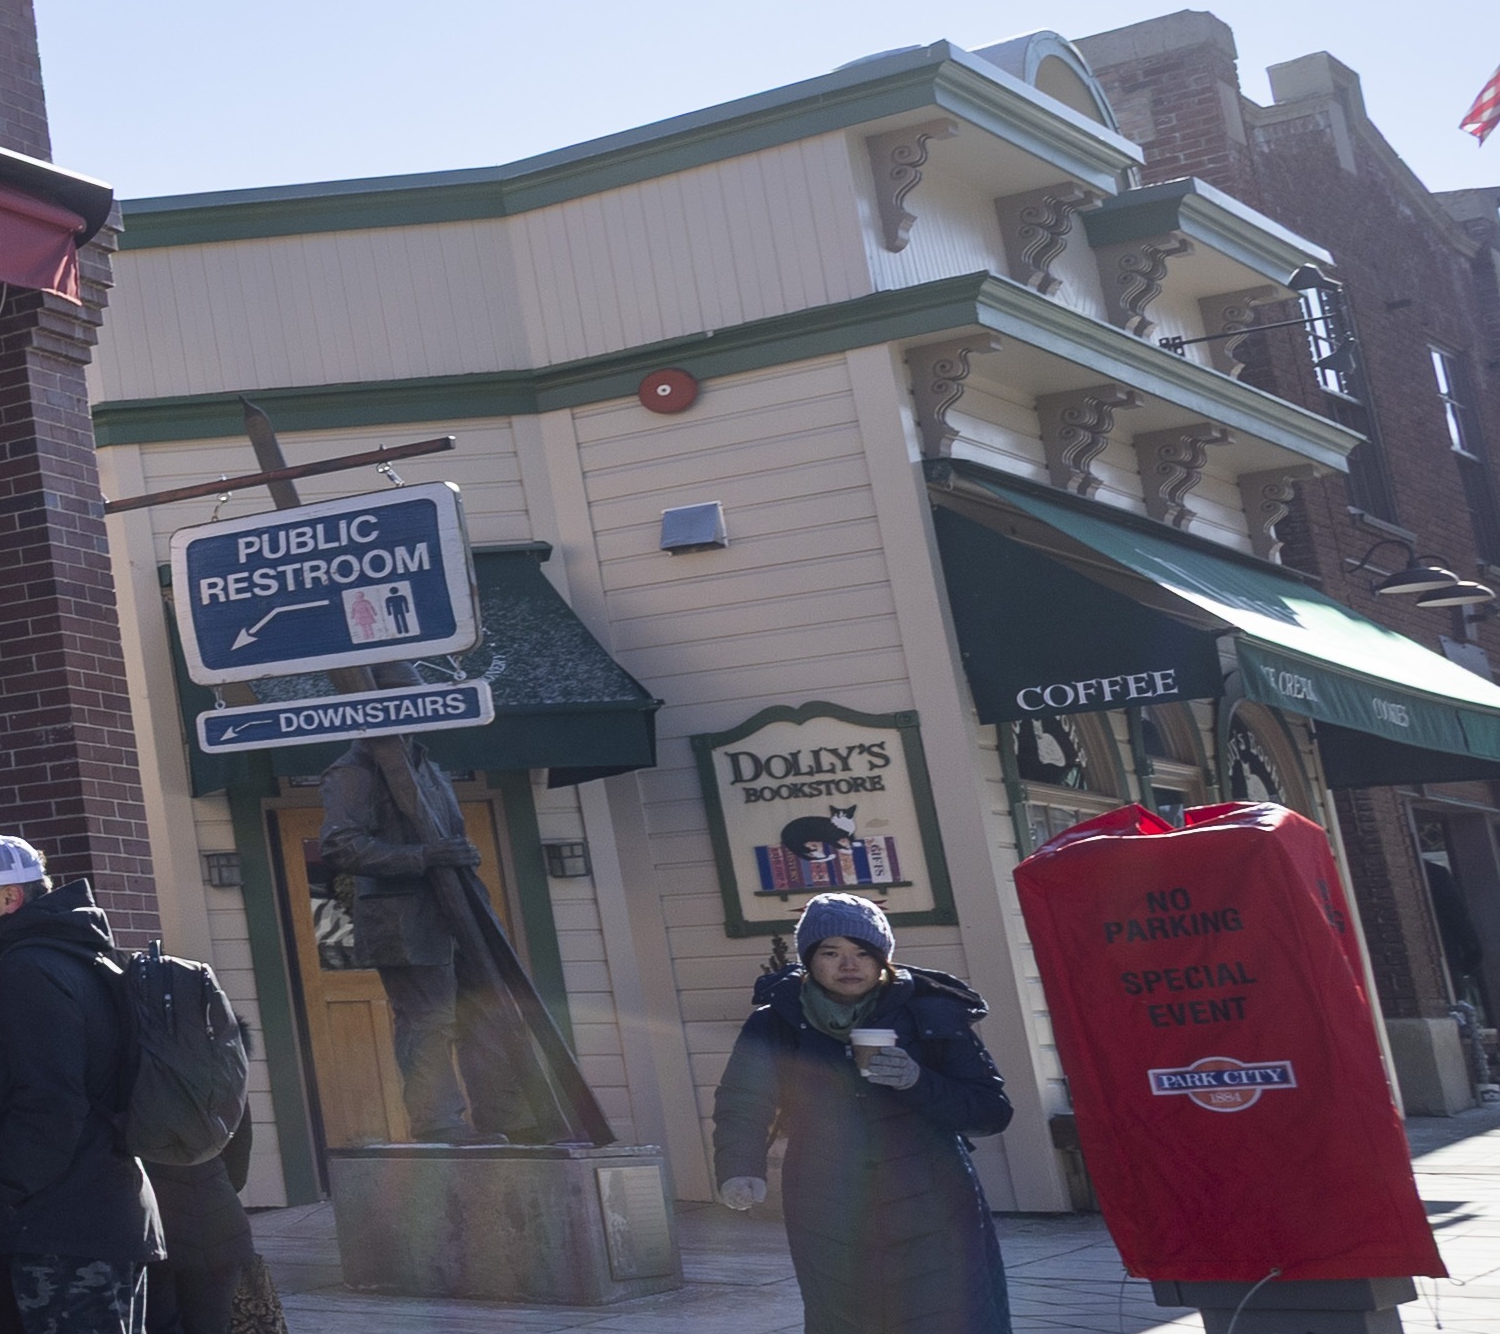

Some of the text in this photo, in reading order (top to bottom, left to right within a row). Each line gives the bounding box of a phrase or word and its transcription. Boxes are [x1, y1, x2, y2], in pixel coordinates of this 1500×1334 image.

[237, 514, 380, 565] PUBLIC
[200, 542, 432, 606] RESTROOM
[1016, 669, 1179, 711] COFFEE
[279, 693, 466, 734] DOWNSTAIRS
[724, 741, 891, 785] DOLLY'S
[742, 775, 886, 804] BOOKSTORE
[871, 844, 885, 877] GIFTS
[1146, 887, 1192, 914] NO
[1103, 907, 1244, 944] PARKING
[1120, 961, 1258, 996] SPECIAL
[1147, 996, 1247, 1029] EVENT
[1159, 1068, 1283, 1089] PARK CITY
[1209, 1092, 1243, 1104] 1884
